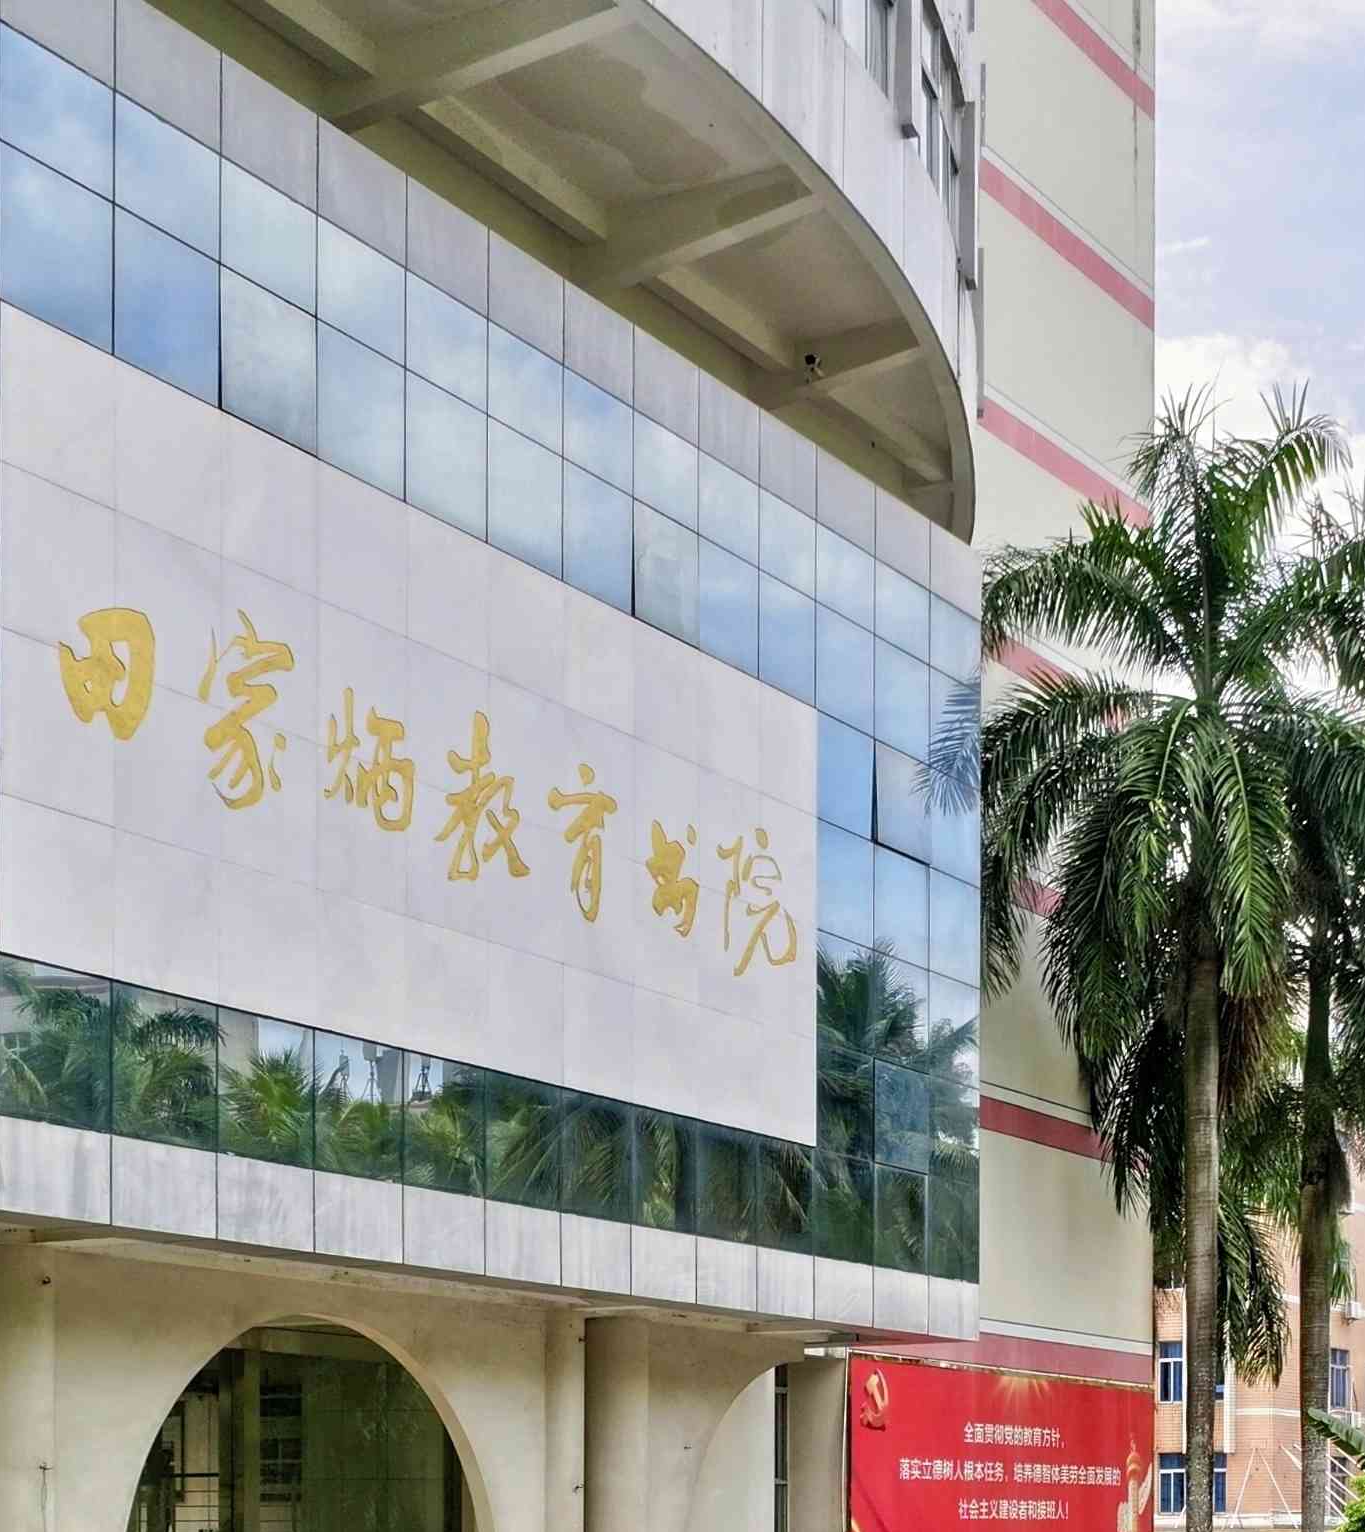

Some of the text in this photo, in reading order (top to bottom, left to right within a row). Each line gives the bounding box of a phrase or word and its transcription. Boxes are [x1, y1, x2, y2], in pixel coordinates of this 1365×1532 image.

[59, 607, 797, 977] 田家炳教育书院
